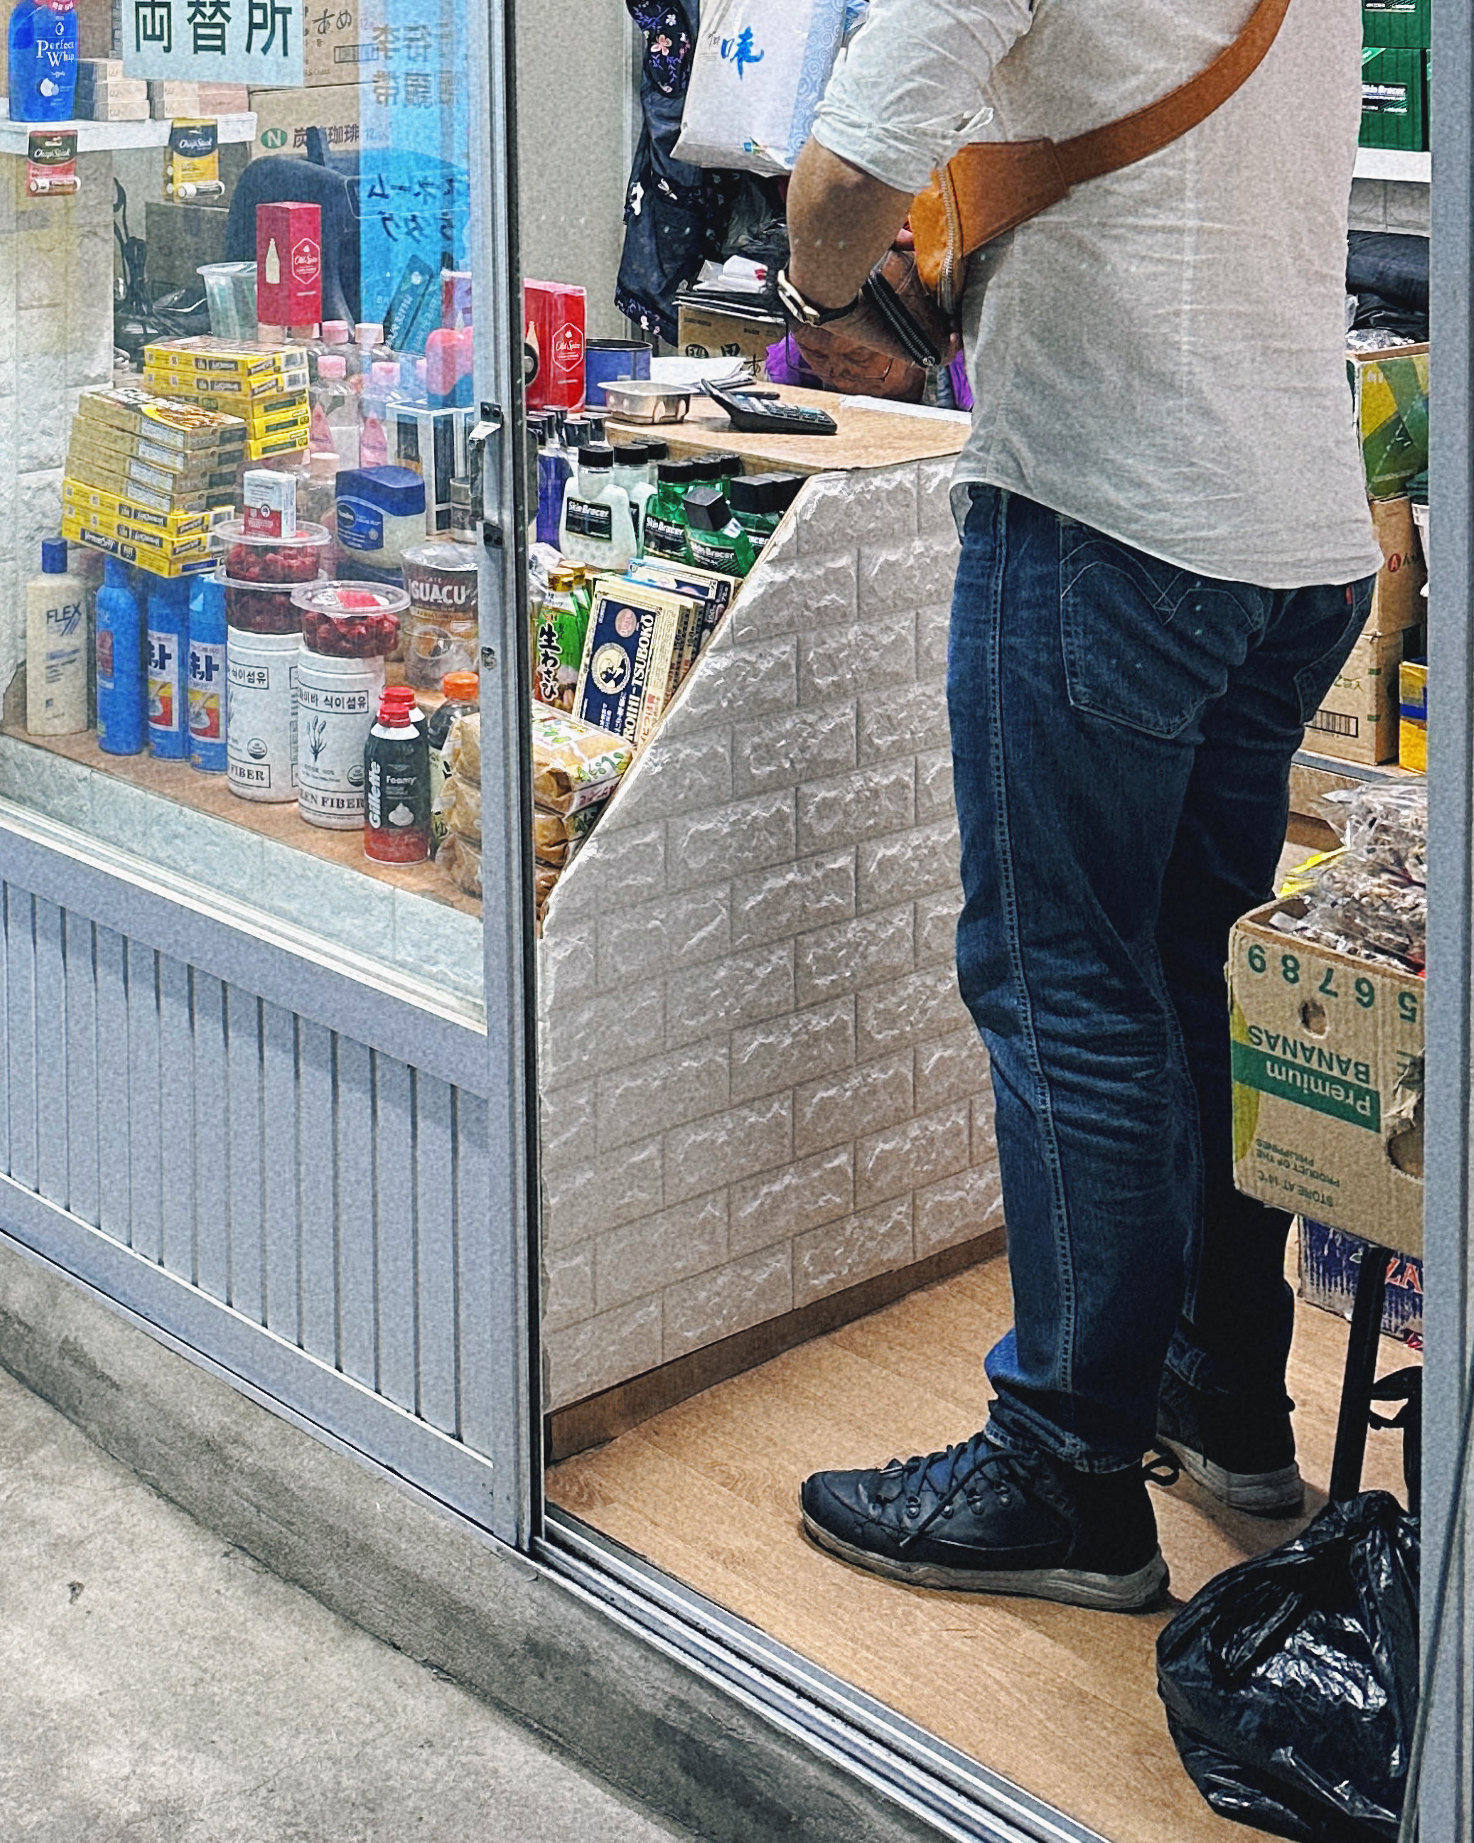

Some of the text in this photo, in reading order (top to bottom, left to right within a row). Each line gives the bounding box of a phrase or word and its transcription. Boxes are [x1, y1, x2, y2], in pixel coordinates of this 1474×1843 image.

[36, 39, 75, 59] Perfect
[45, 50, 75, 68] Whip
[266, 127, 283, 148] N
[292, 123, 360, 149] 炭珈琲
[568, 501, 610, 518] Skin Bracer
[646, 517, 659, 530] Skin
[45, 602, 83, 625] FLEX
[537, 622, 562, 702] 生わさび
[323, 695, 368, 710] 식이섬유
[230, 764, 266, 782] FIBER
[386, 775, 418, 787] Foamy
[368, 758, 382, 829] Gillette
[1247, 943, 1419, 1023] 5 6 7 8 9
[1246, 1024, 1371, 1086] BANANAS
[1264, 1059, 1373, 1117] Premium
[1293, 1159, 1341, 1189] PRODUCT
[1281, 1178, 1295, 1194] AT
[1297, 1184, 1334, 1209] STORE
